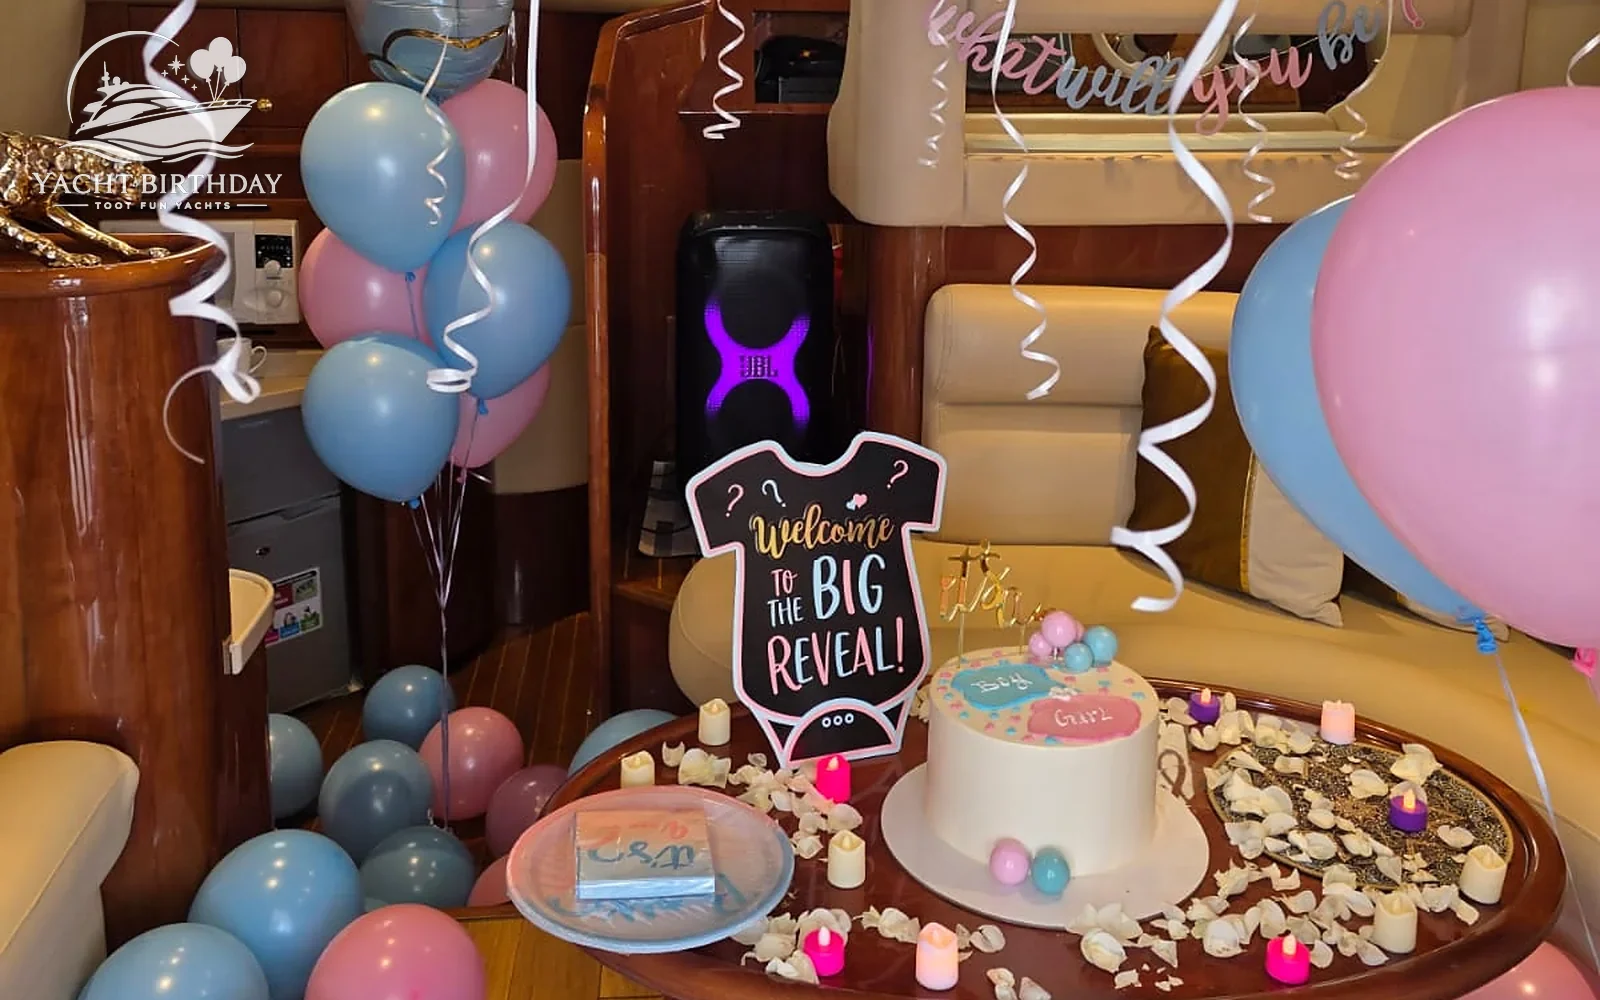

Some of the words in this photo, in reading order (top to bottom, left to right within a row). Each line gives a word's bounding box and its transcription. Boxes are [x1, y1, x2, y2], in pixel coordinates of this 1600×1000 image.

[1193, 47, 1312, 135] you
[740, 355, 778, 377] JBL
[751, 503, 895, 559] Welcome
[771, 567, 798, 597] TO
[812, 553, 886, 620] BIG
[767, 596, 804, 627] THE
[767, 616, 905, 696] REVEAL!
